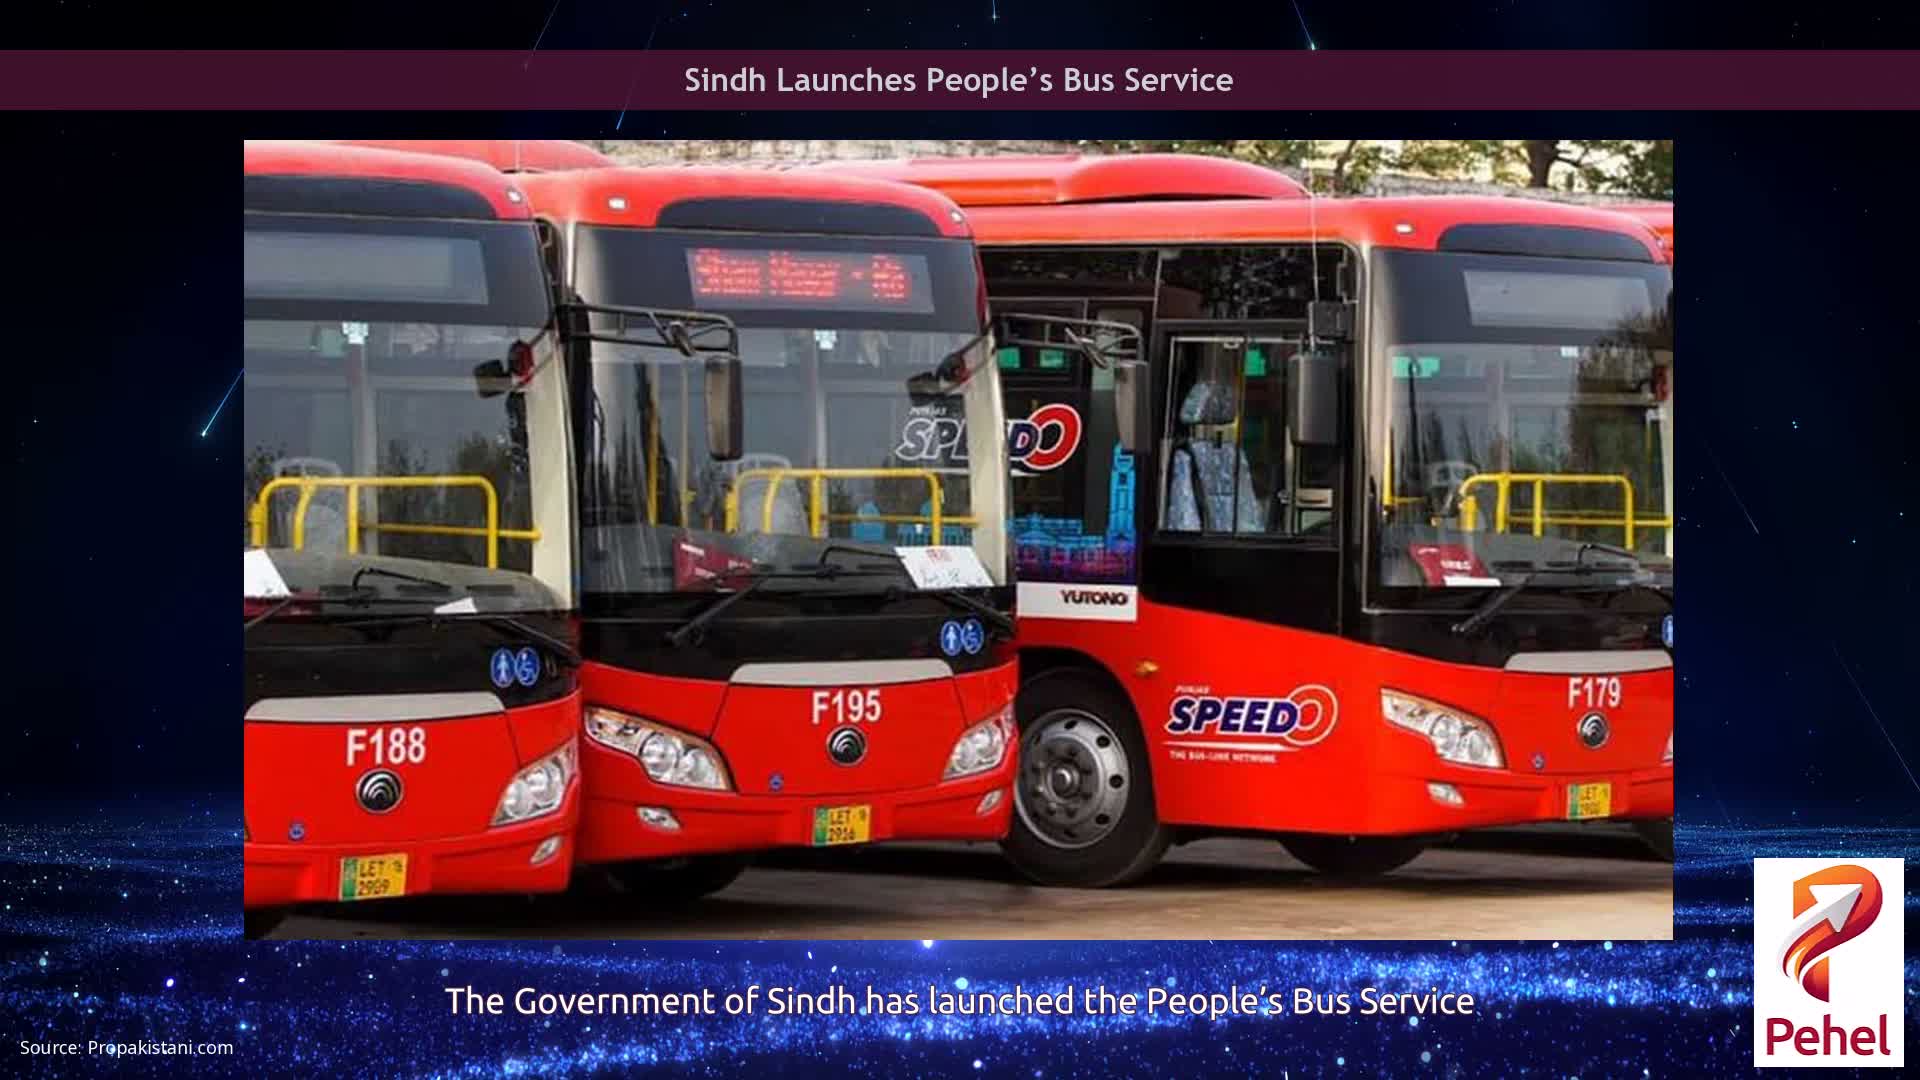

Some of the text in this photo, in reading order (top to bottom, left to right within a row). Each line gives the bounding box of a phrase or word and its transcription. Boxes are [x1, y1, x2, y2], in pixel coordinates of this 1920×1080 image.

[811, 689, 881, 724] F195
[1567, 676, 1621, 709] F179
[1164, 684, 1338, 746] SPEEDO
[346, 727, 426, 767] F188
